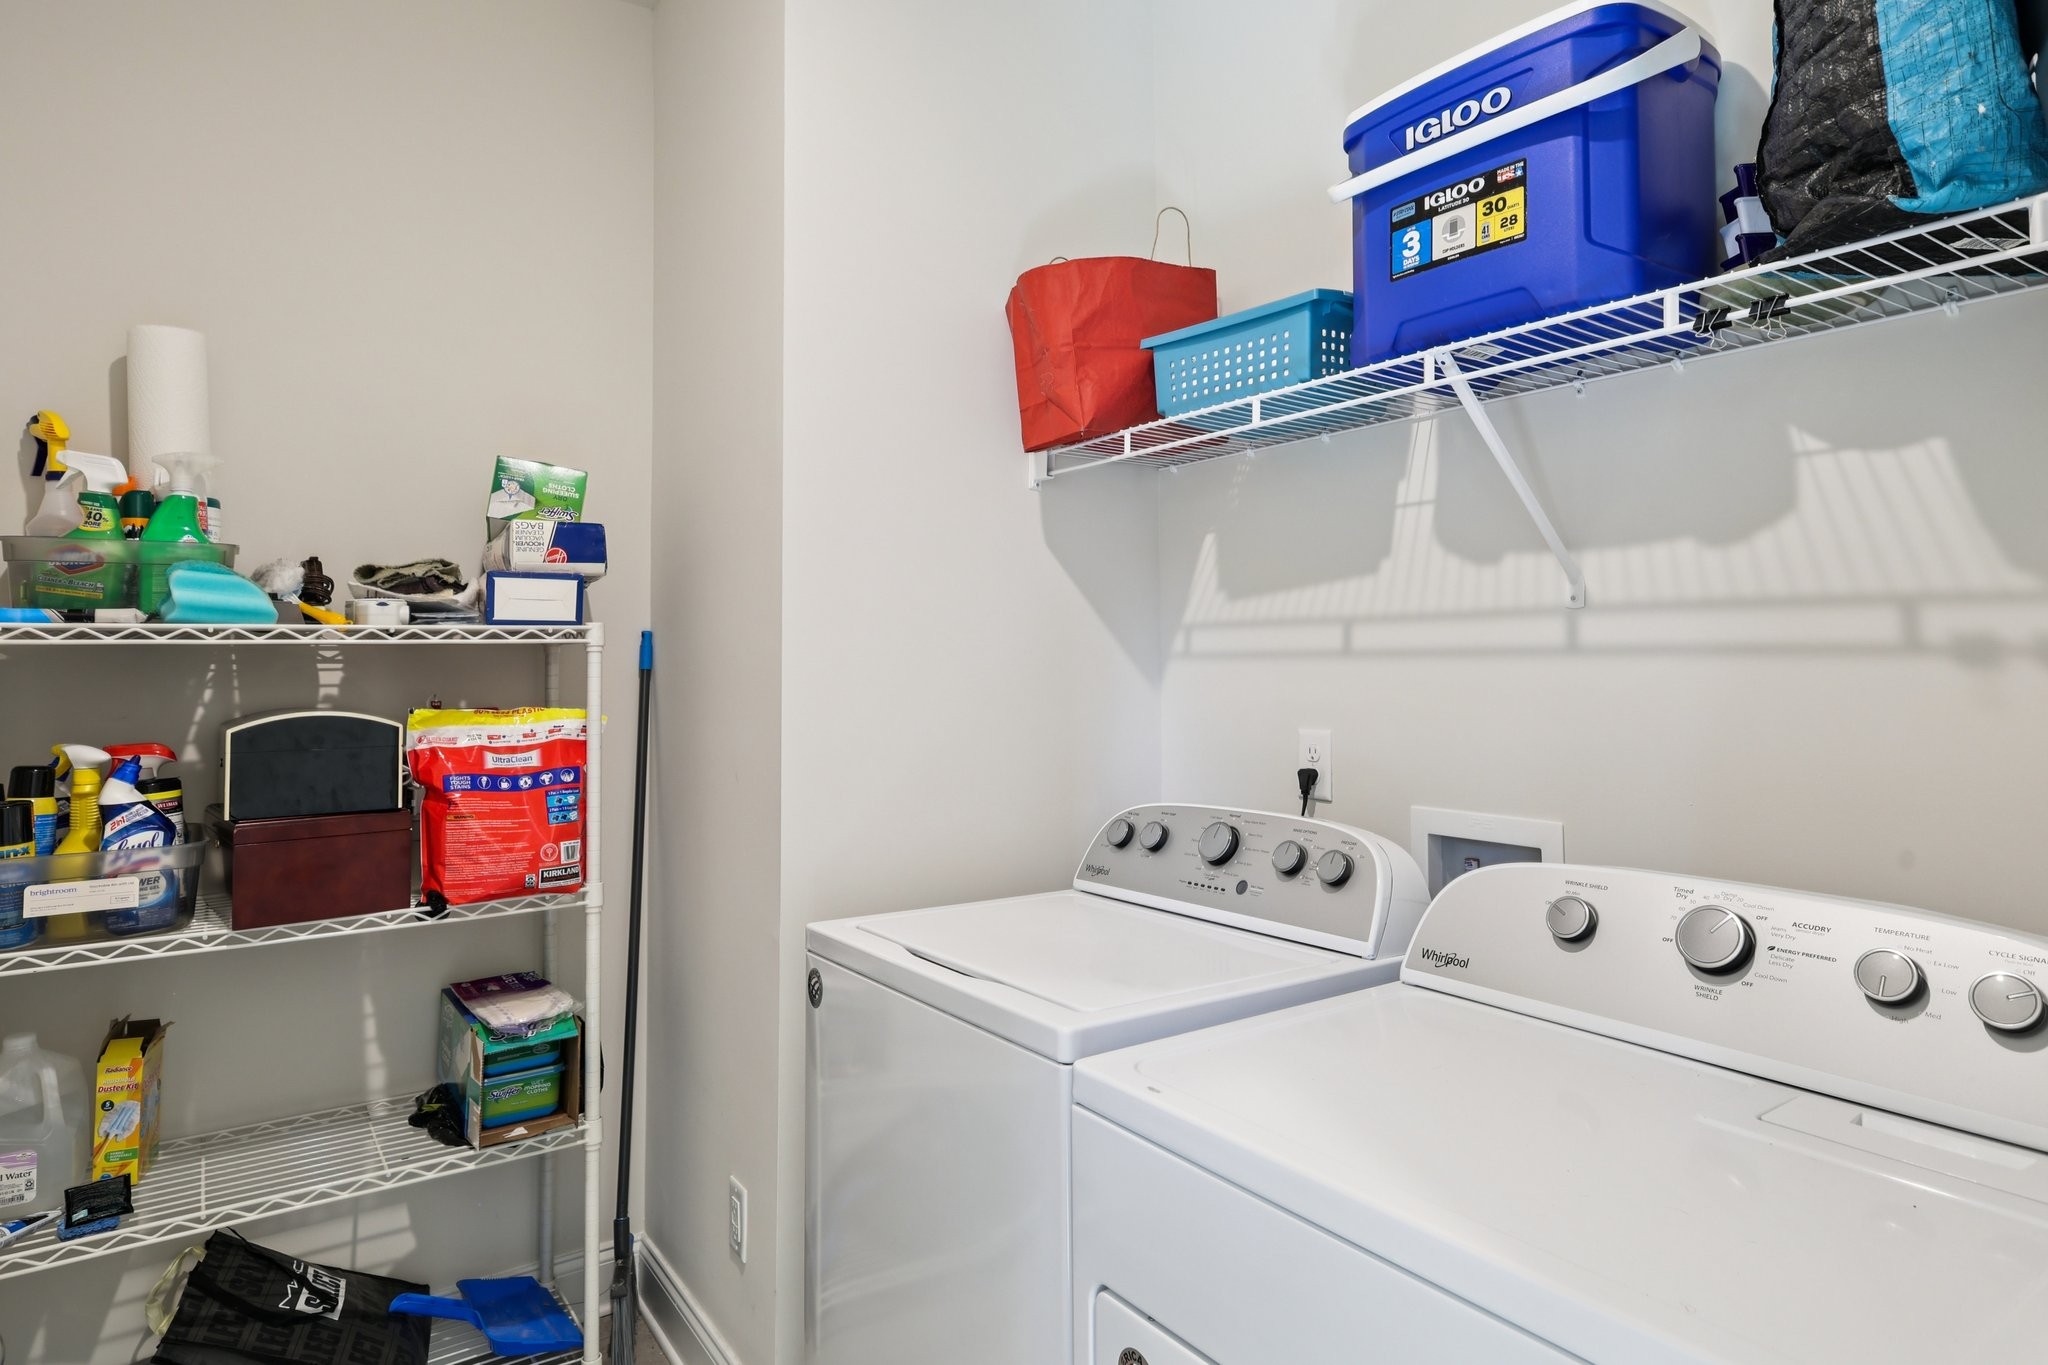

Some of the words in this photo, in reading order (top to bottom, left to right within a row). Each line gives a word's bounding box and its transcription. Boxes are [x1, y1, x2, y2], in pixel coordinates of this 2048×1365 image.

[1405, 86, 1511, 151] IGLOO
[1424, 177, 1485, 210] IGLOO
[1482, 197, 1507, 217] 30
[1500, 214, 1518, 229] 28
[1482, 225, 1490, 234] 41
[1402, 230, 1421, 258] 3
[1403, 255, 1420, 266] DAYS
[538, 506, 579, 521] Swiffer
[110, 816, 126, 831] 2in1
[543, 867, 579, 878] KIRKLAND
[1085, 864, 1111, 876] Whirlpool
[1565, 880, 1588, 888] WRINKLE
[1589, 883, 1608, 891] SHIELD
[30, 888, 77, 897] brightroom
[1676, 892, 1688, 900] Dry
[1758, 904, 1775, 912] Down
[1792, 921, 1831, 933] ACCUDRY
[1771, 931, 1784, 939] Very
[1874, 927, 1930, 941] TEMPERATURE
[1776, 947, 1800, 956] ENERGY
[1801, 952, 1837, 963] PREFERRED
[1915, 946, 1933, 955] Heat
[1421, 947, 1470, 969] Whirlpool
[1770, 954, 1795, 962] Delicate
[1989, 950, 2016, 960] CYCLE
[2019, 953, 2048, 965] SIGNA
[1943, 962, 1960, 970] Low
[1755, 972, 1768, 980] Cool
[1769, 975, 1787, 983] Down
[1694, 985, 1723, 995] WRINKLE
[1696, 992, 1719, 1001] SHIELD
[1891, 1015, 1909, 1025] High
[1925, 1011, 1941, 1020] Med
[98, 1085, 125, 1093] Duster
[5, 1171, 32, 1180] Water
